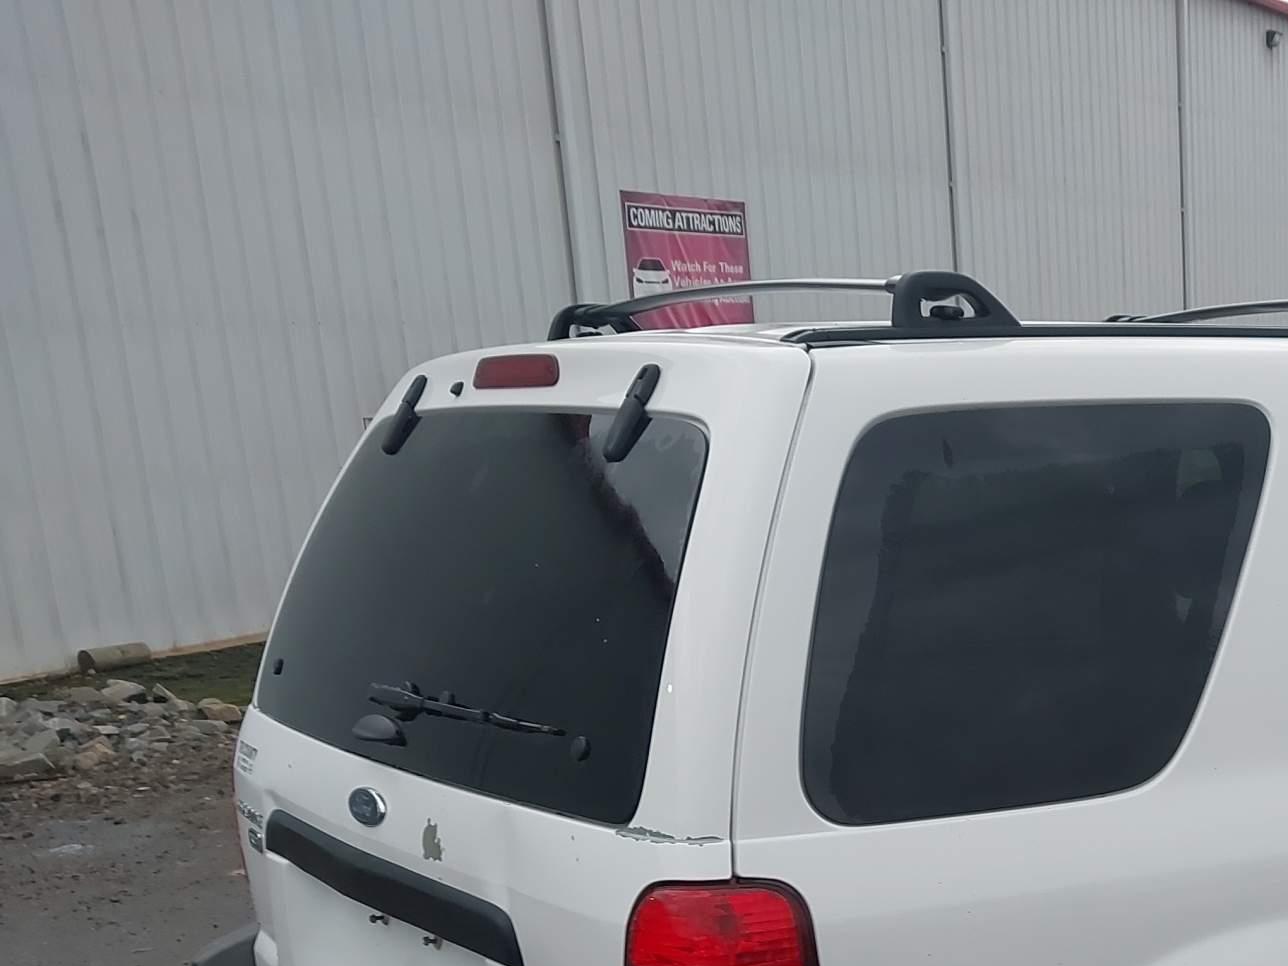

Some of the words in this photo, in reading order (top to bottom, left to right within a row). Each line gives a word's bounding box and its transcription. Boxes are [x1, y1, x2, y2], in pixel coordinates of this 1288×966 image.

[629, 207, 674, 229] COMING
[674, 211, 742, 233] ATTRACTIONS
[672, 260, 701, 272] Watch
[703, 261, 716, 273] For
[719, 261, 744, 273] These
